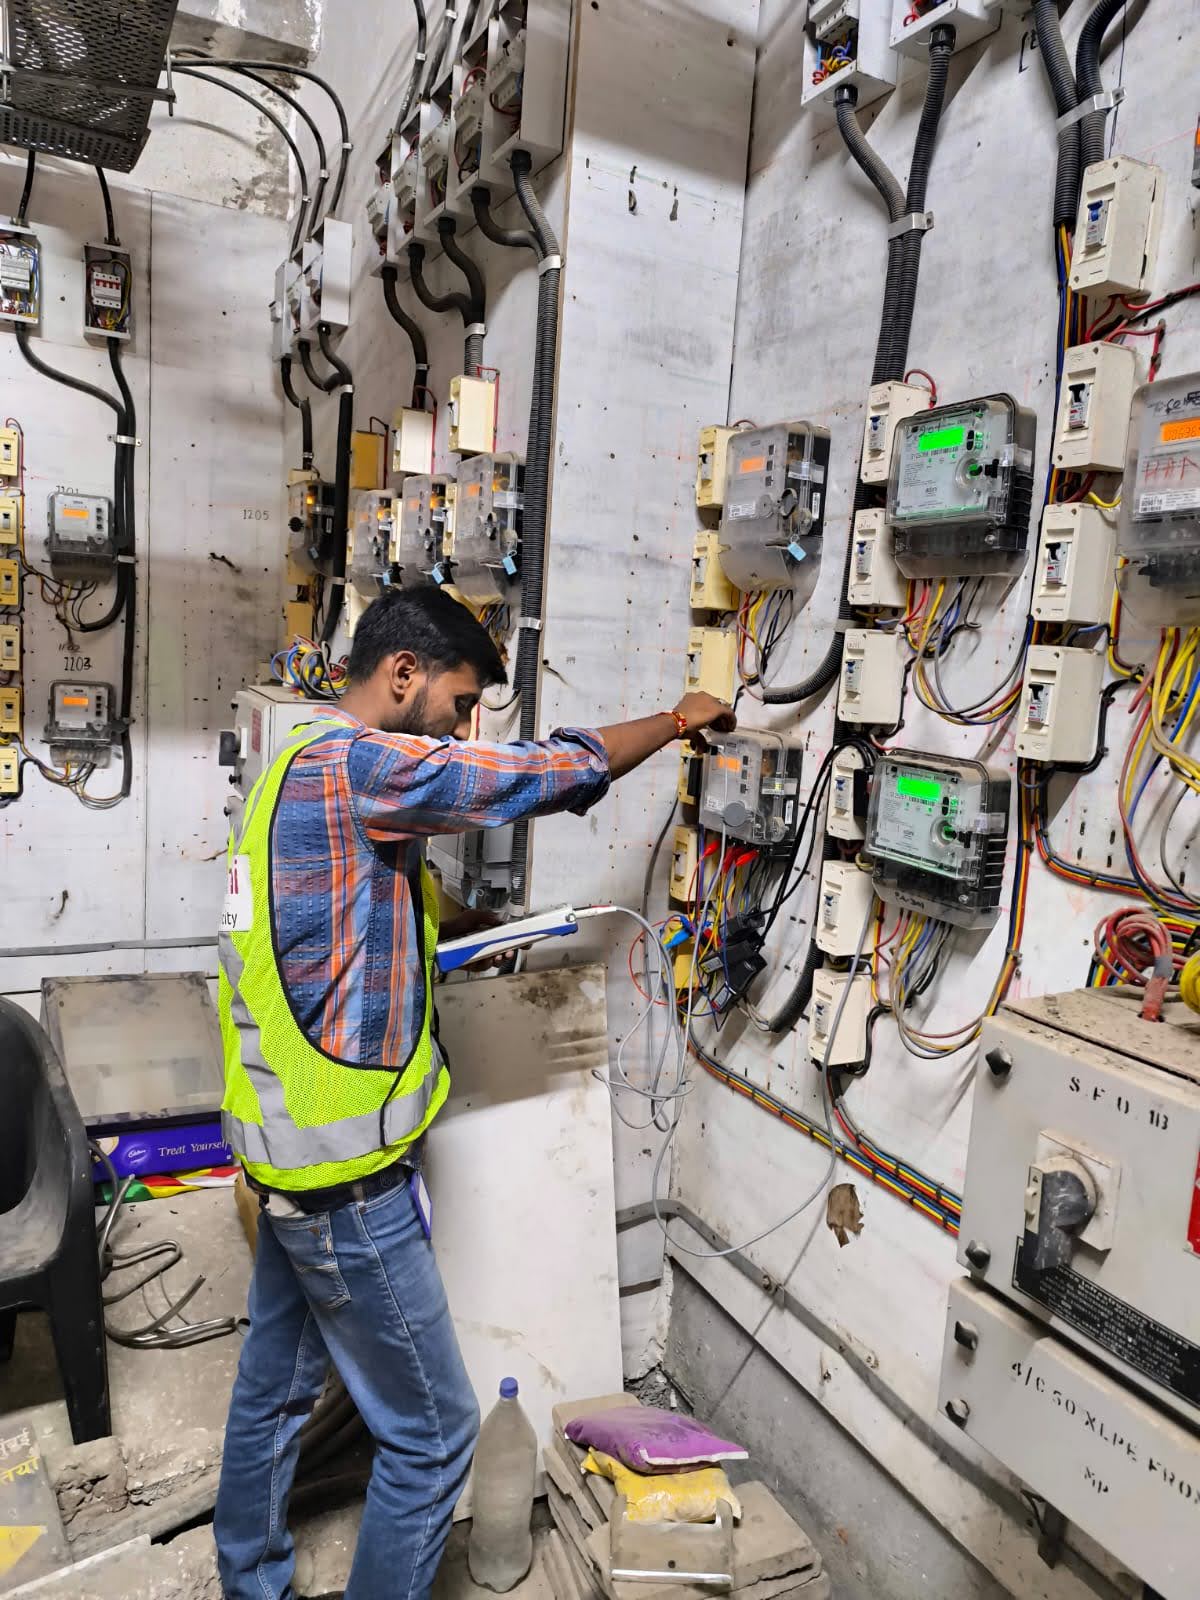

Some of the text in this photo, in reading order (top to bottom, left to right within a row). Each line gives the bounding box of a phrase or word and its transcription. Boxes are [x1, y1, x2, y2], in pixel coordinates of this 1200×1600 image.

[243, 509, 270, 521] 1205
[158, 1145, 186, 1157] Treat
[1084, 1411, 1137, 1462] XLPE
